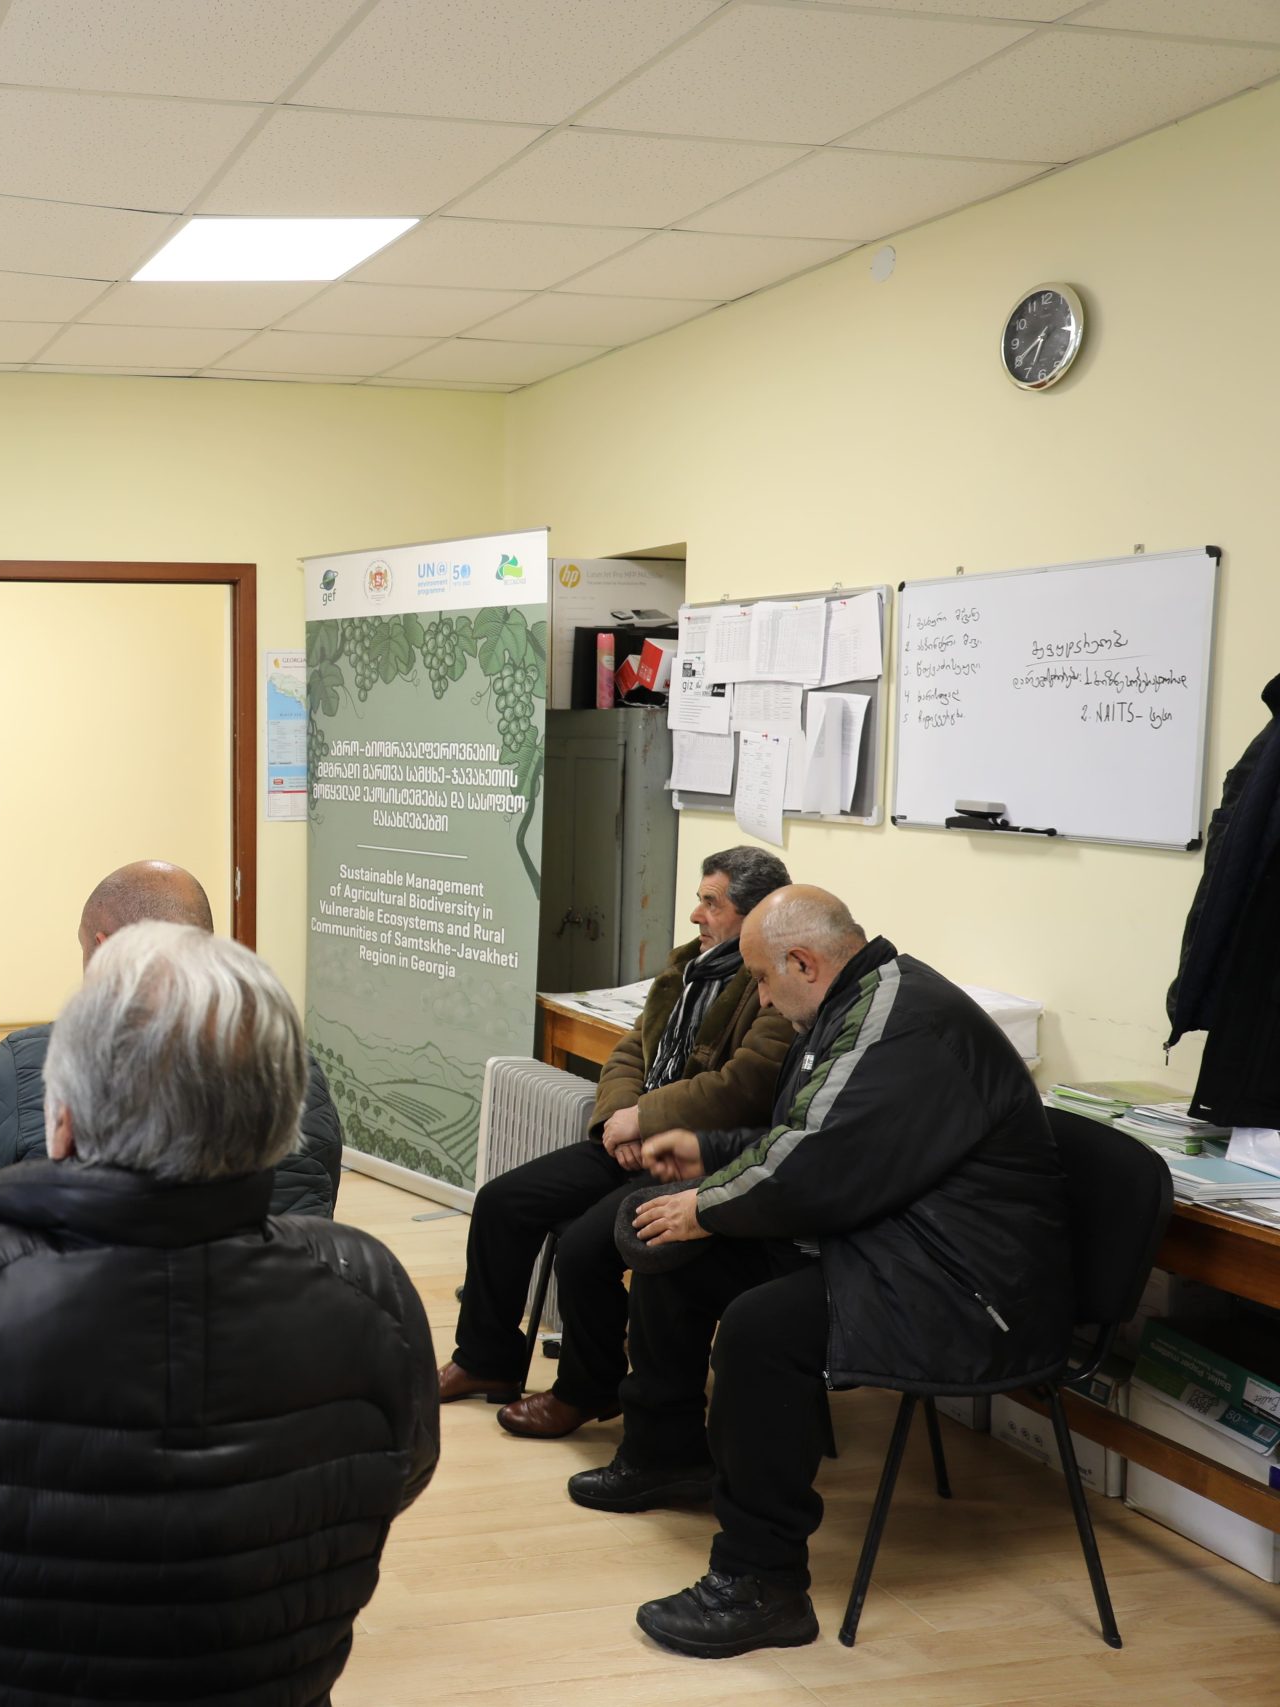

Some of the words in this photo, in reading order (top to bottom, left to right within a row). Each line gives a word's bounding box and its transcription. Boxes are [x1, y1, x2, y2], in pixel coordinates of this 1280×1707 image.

[1028, 301, 1037, 314] 11
[1041, 293, 1053, 305] 12
[1016, 319, 1027, 331] 10
[1011, 338, 1020, 350] 9
[1024, 367, 1032, 379] 7
[1038, 369, 1047, 380] 6
[418, 562, 435, 578] UN
[322, 589, 336, 606] gef
[317, 761, 361, 779] მდგრადი
[362, 764, 404, 782] მართვა
[406, 766, 518, 788] სამცხე-ჯავახეთის
[313, 783, 361, 802] მოწყვლად
[363, 787, 448, 808] ეკოსისტემებსა
[450, 792, 465, 809] და
[467, 793, 525, 814] სასოფლო
[373, 809, 449, 832] დასახლებებში
[339, 864, 403, 886] Sustainable
[406, 872, 484, 897] Management
[330, 883, 342, 897] of
[344, 885, 407, 907] Agricultural
[409, 894, 480, 921] Biodiversity
[482, 903, 493, 920] in
[320, 899, 374, 922] Vulnerable
[377, 908, 444, 932] Ecosystems
[447, 922, 471, 938] and
[473, 925, 505, 945] Rural
[311, 917, 378, 942] Communities
[380, 930, 392, 945] of
[394, 931, 519, 969] Samtskhe-Javakheti
[359, 945, 397, 968] Region
[398, 952, 409, 968] in
[410, 955, 456, 980] Georgia
